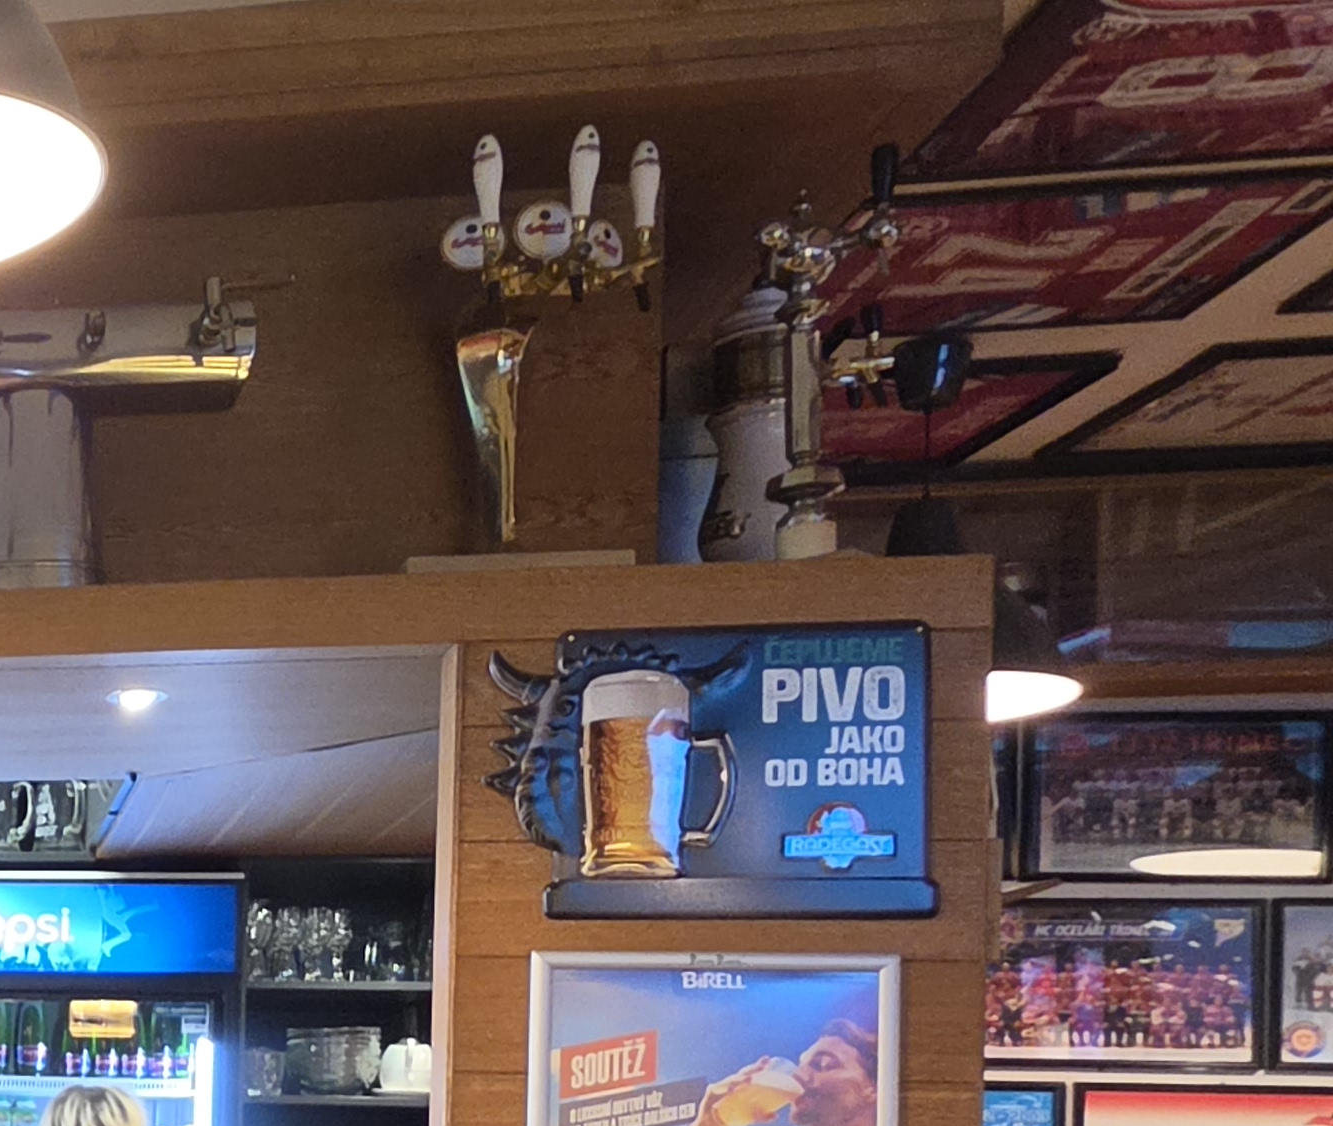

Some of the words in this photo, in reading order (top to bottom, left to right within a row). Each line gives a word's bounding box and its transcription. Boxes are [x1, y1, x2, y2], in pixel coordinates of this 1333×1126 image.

[764, 635, 904, 665] ČEPUJEME
[762, 665, 906, 724] PIVO
[824, 725, 905, 755] JAKO
[765, 758, 808, 787] OD
[817, 757, 905, 787] BOHA
[790, 836, 891, 855] RADEGAST
[570, 1037, 647, 1090] SOUTĚŽ
